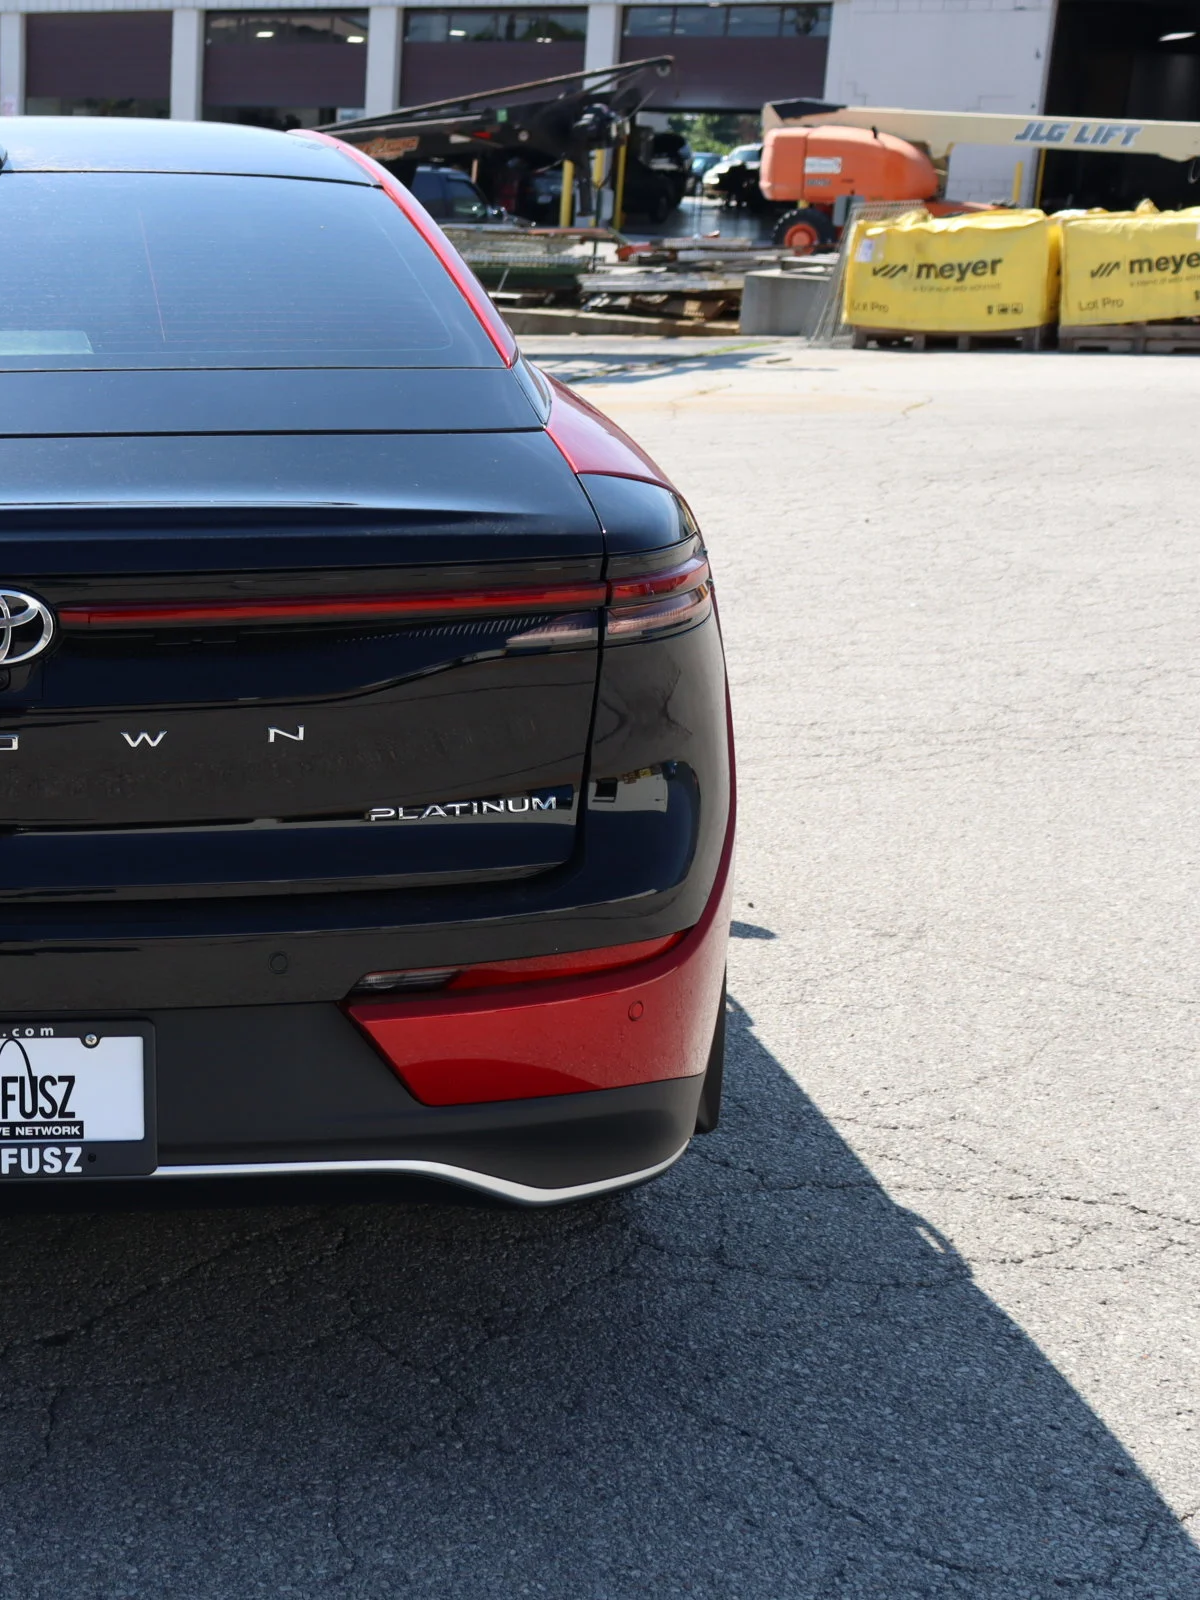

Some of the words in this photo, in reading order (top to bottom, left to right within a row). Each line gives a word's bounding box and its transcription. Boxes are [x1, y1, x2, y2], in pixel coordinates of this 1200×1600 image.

[1014, 122, 1070, 142] JLG
[1073, 124, 1142, 146] LIFT
[916, 257, 1003, 282] meyer
[368, 796, 557, 822] PLATINUM
[1, 1075, 76, 1120] FUSZ
[15, 1124, 81, 1137] NETWORK
[0, 1146, 83, 1174] FUSZ
